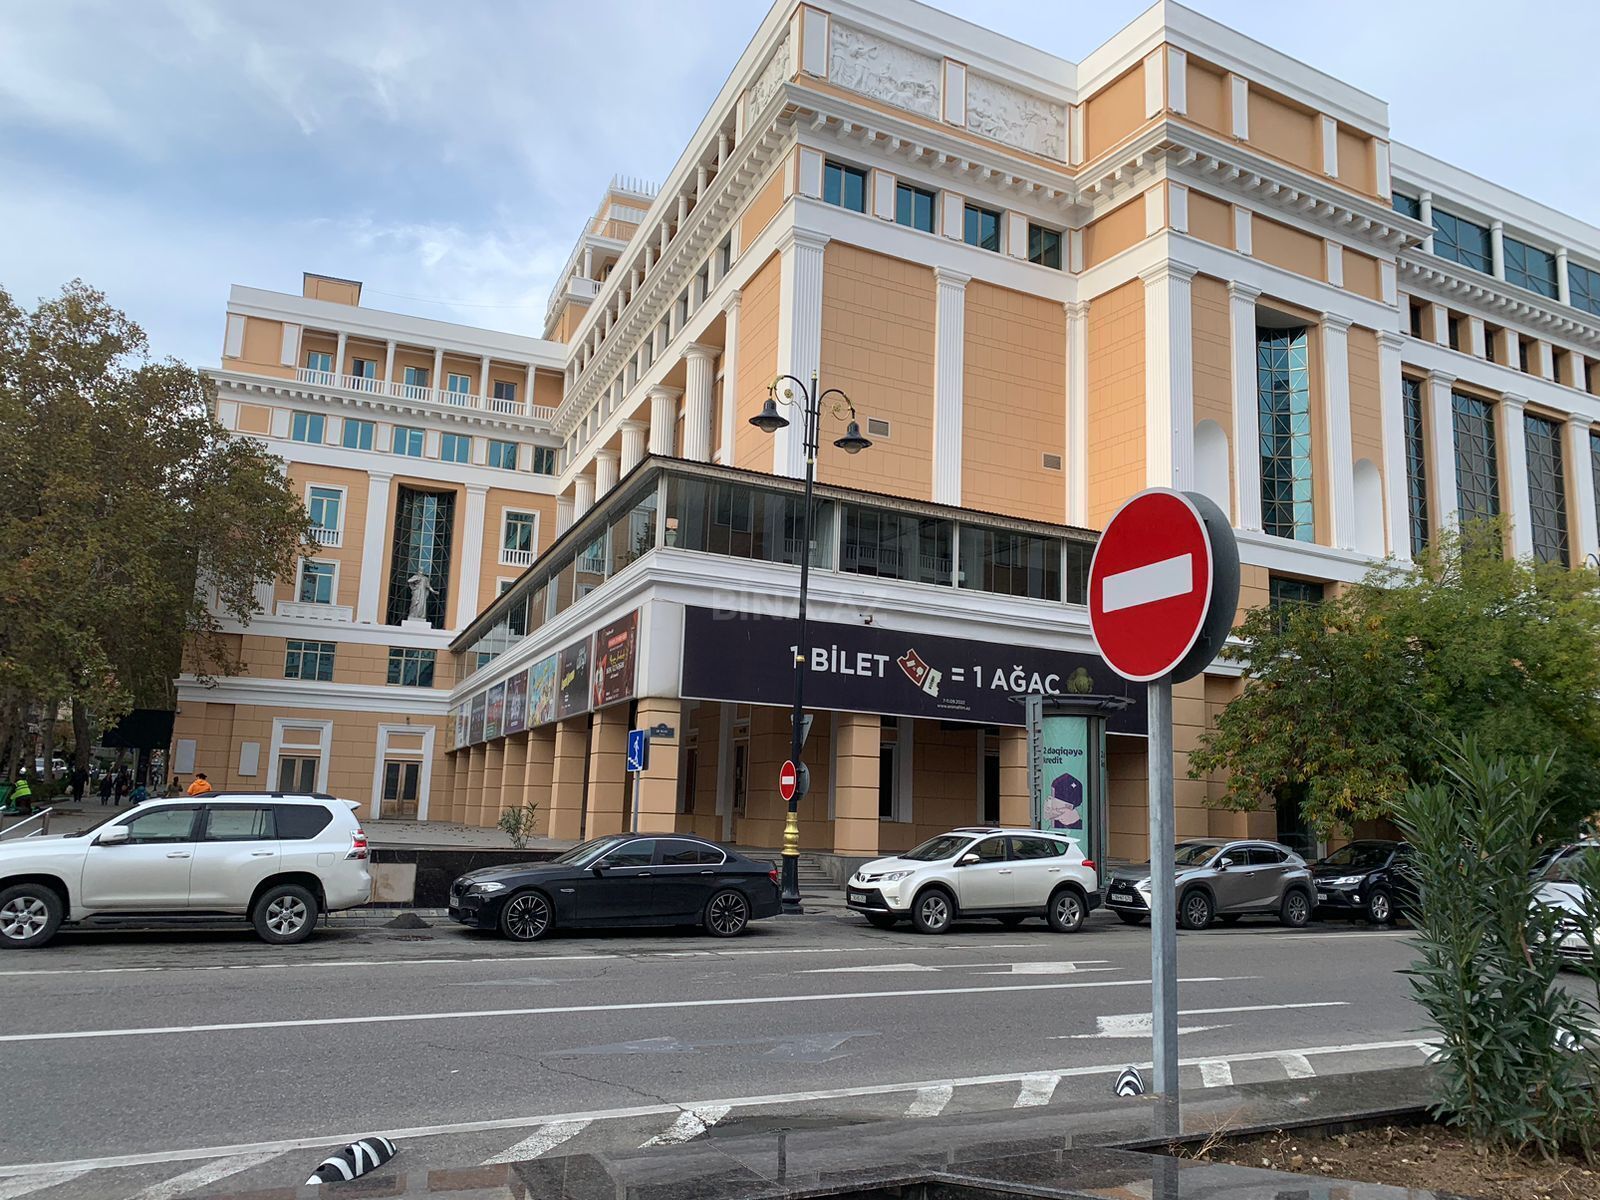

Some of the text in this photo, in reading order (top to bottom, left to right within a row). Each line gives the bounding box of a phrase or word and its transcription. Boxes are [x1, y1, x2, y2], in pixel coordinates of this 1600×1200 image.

[790, 644, 1060, 694] 1 BİLET = 1 AĞAC
[1047, 746, 1083, 757] dəqiqəyə
